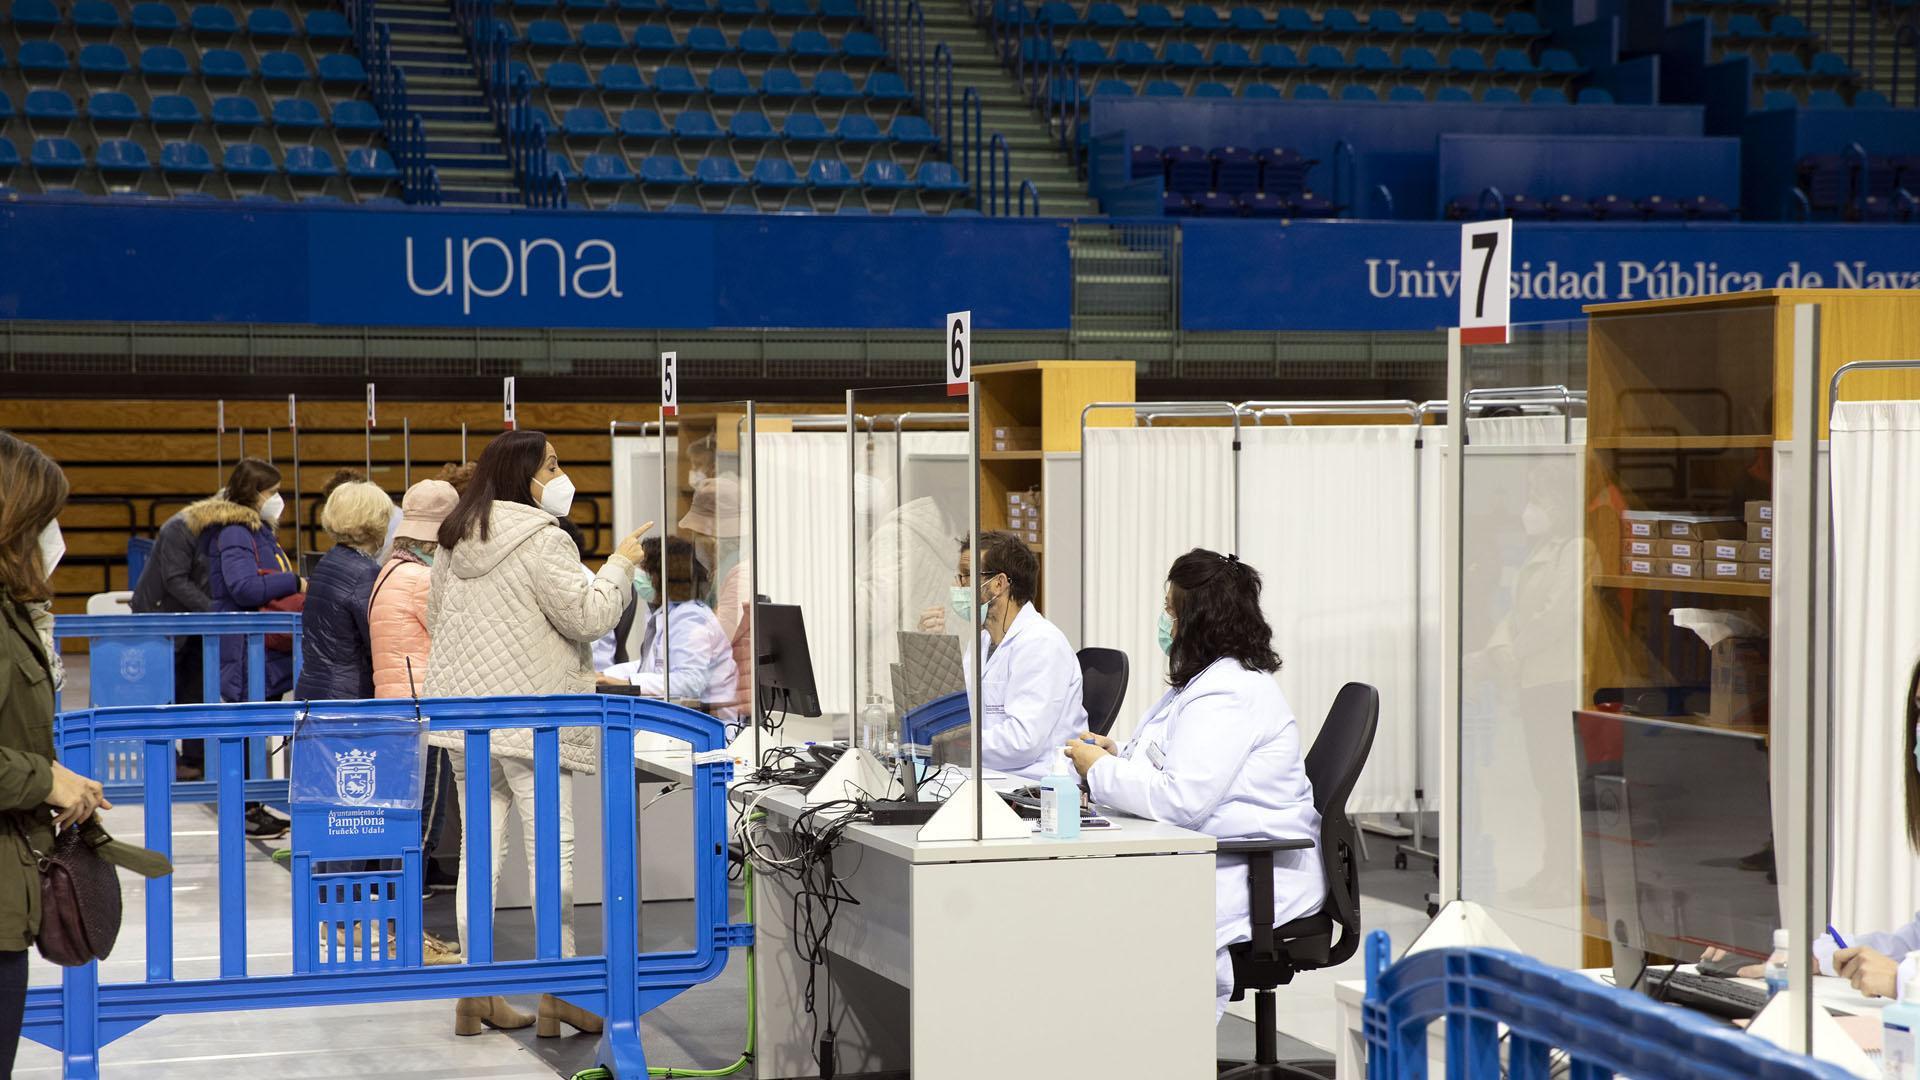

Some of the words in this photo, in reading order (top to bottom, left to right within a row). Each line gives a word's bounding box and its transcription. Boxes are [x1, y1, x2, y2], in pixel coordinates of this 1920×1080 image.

[406, 236, 623, 315] upna
[1365, 259, 1608, 299] Univsidad
[1618, 260, 1764, 299] Pública
[1776, 261, 1823, 288] de
[1472, 232, 1498, 318] 7
[951, 318, 964, 378] 6
[506, 381, 512, 417] 4
[664, 358, 673, 402] 5
[328, 809, 374, 817] Ayuntamiento
[376, 807, 385, 816] de
[328, 816, 385, 829] Pamplona
[362, 826, 385, 834] Udala
